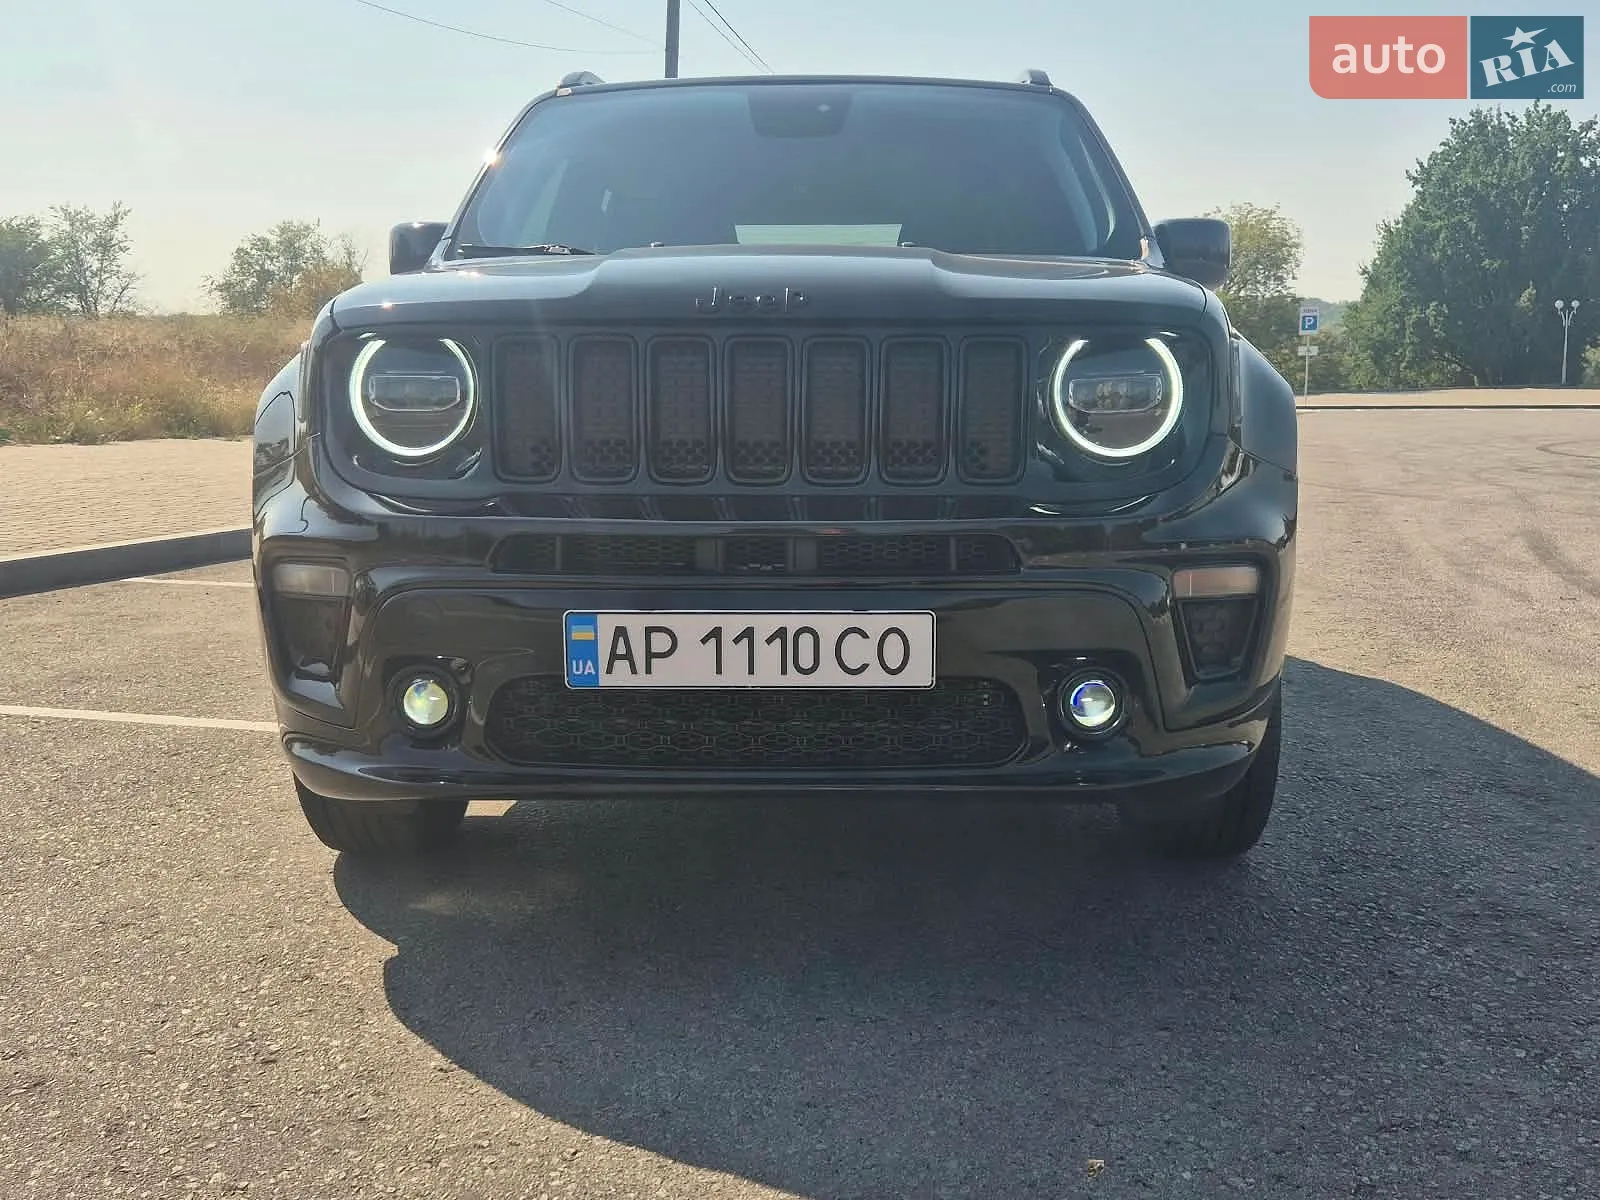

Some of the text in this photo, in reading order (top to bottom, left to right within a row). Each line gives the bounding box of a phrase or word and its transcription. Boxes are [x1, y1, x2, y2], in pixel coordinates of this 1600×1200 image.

[1305, 316, 1314, 329] P
[605, 626, 911, 676] AP 1110 CO
[572, 660, 596, 675] UA
